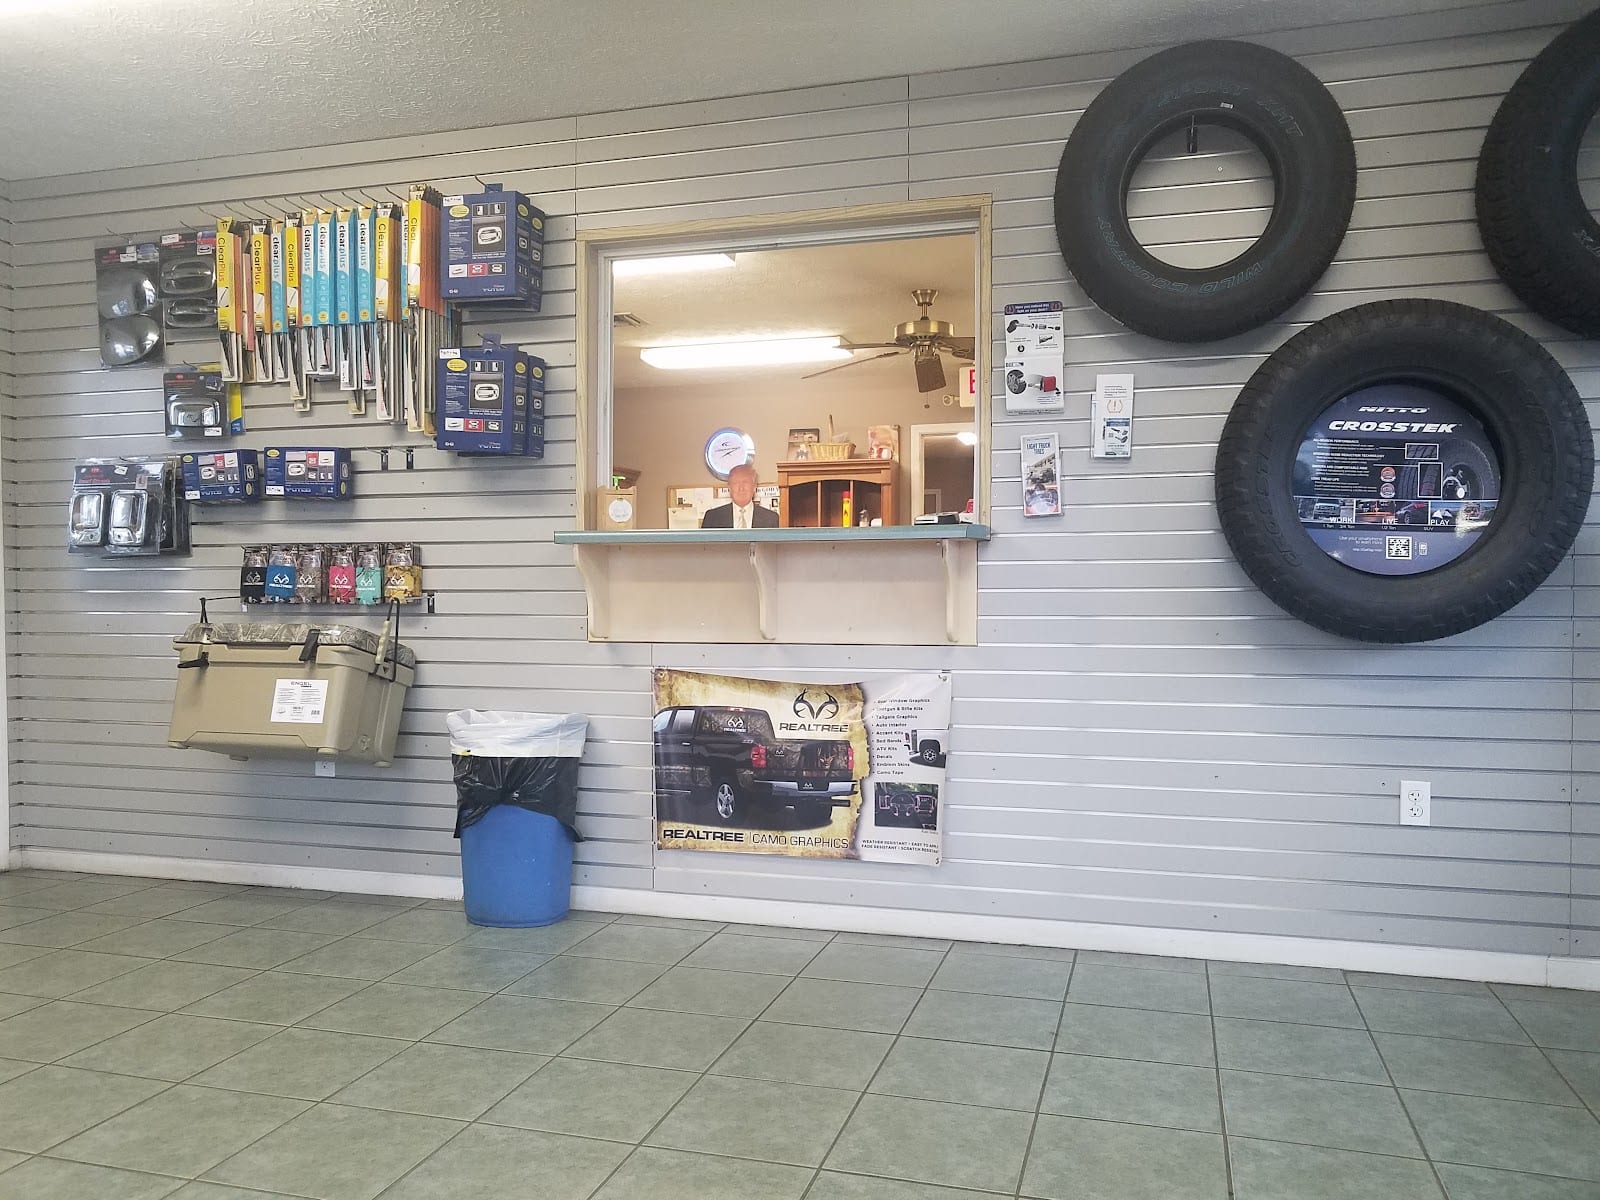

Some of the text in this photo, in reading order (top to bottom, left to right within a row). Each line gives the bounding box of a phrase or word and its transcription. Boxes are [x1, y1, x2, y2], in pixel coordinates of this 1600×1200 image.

[1199, 262, 1265, 294] WILD
[1358, 406, 1428, 414] NITTO
[1328, 421, 1456, 433] CROSSTEK
[779, 721, 848, 733] REALTREE
[663, 829, 848, 849] REALTREE CAMO GRAPHICS
